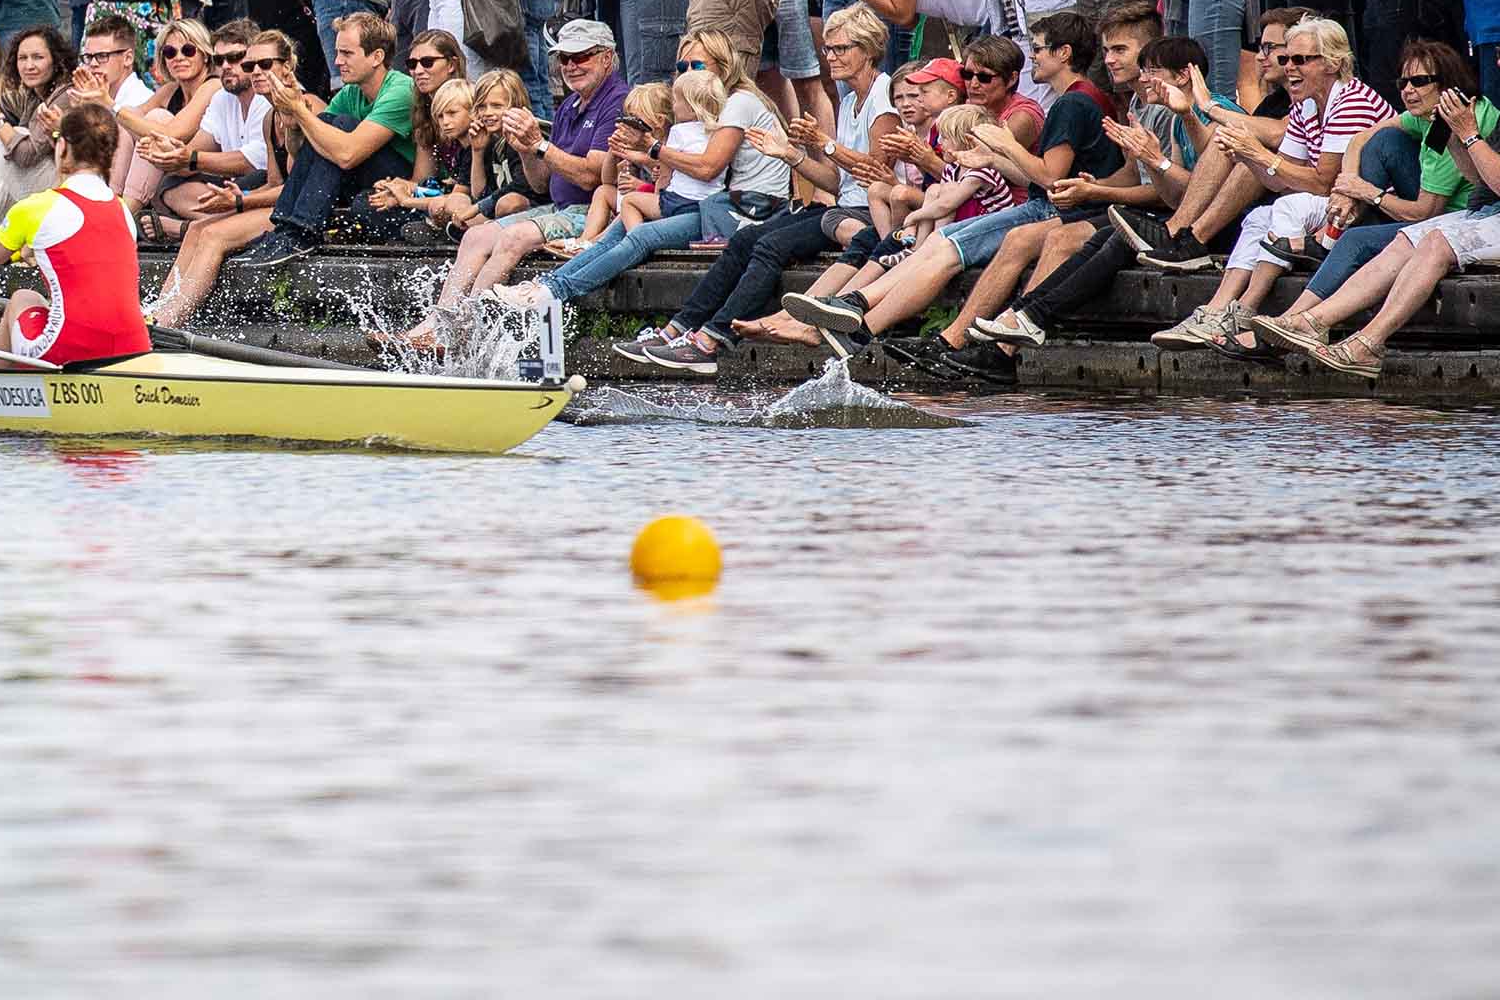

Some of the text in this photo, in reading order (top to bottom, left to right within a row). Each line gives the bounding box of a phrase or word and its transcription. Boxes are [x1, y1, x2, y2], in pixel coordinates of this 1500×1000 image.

[543, 306, 554, 354] 1
[80, 383, 104, 406] 001
[133, 384, 160, 404] Erich
